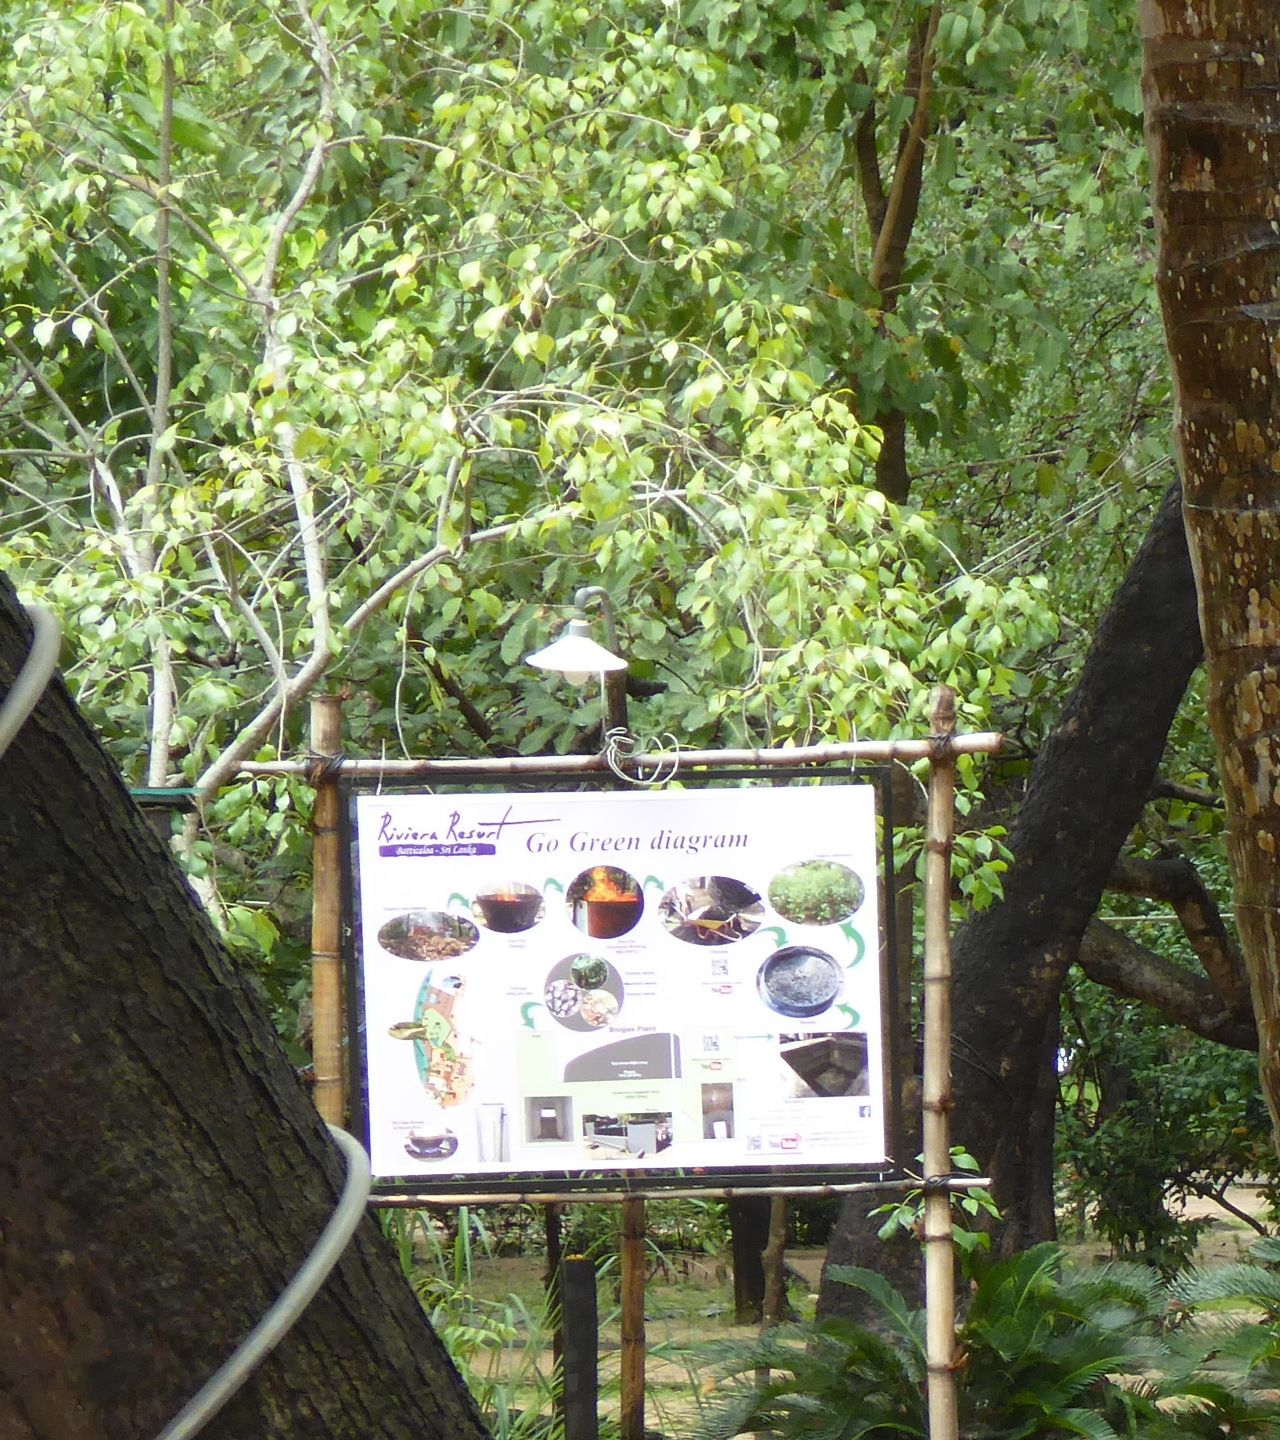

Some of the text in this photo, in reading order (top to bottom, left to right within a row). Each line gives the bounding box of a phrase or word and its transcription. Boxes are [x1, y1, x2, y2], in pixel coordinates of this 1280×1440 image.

[377, 805, 561, 842] Riviera Resort
[526, 829, 748, 854] Go Green diagram
